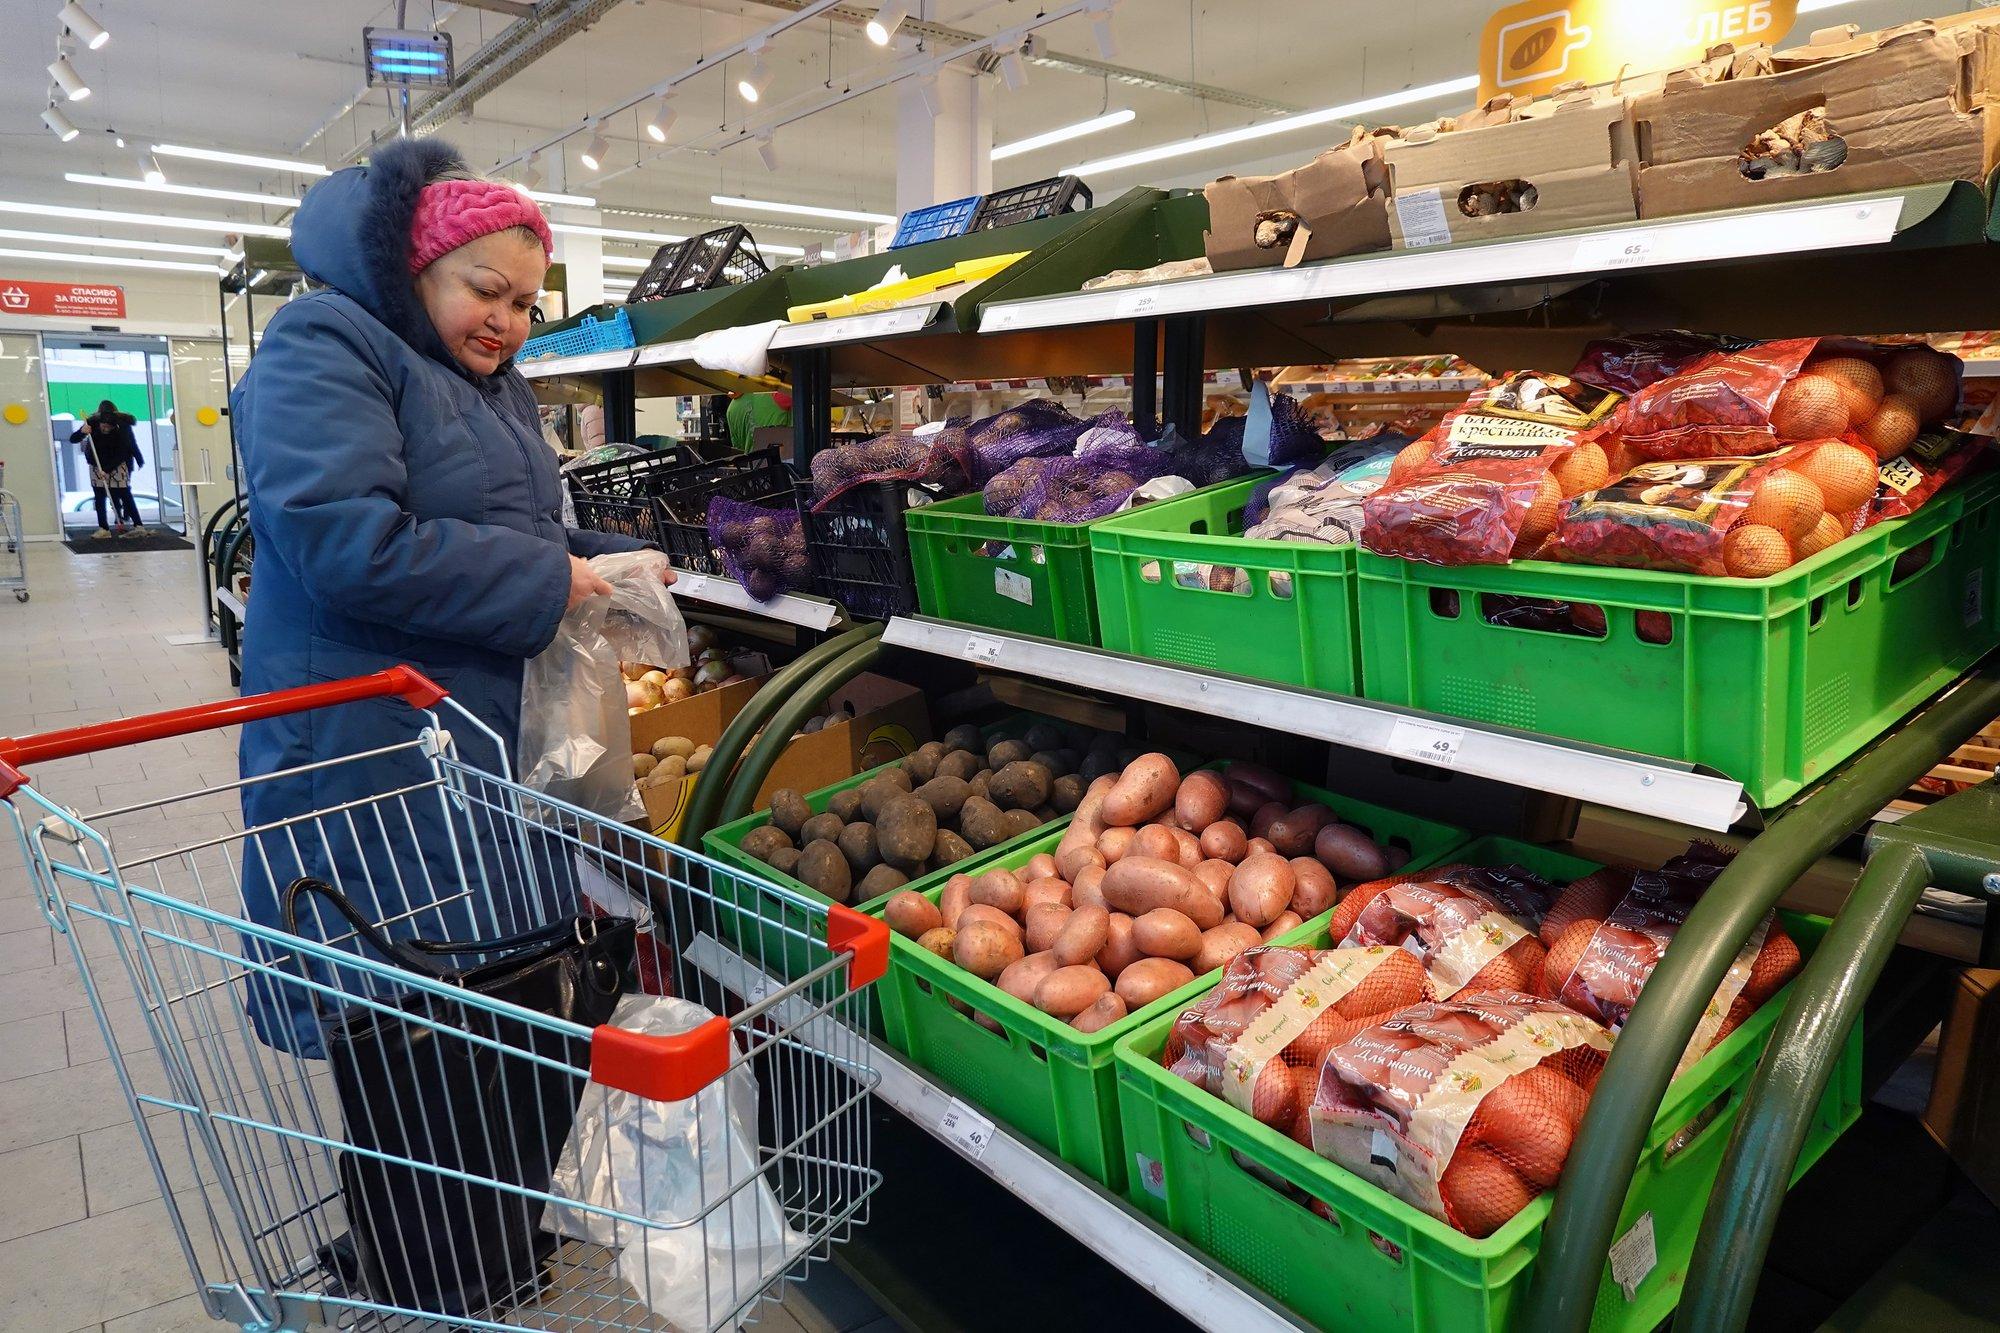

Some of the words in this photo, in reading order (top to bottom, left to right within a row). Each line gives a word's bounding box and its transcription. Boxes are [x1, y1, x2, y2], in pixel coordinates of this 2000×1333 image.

[1624, 244, 1642, 255] 65
[71, 287, 117, 297] СПАСИБО
[55, 294, 69, 303] ЗА
[70, 295, 118, 305] ПОКУПКУ!
[1456, 447, 1538, 458] КАРТОФЕЛЬ
[1432, 741, 1450, 752] 49
[1407, 890, 1433, 904] Для
[1599, 960, 1631, 983] Для
[1247, 981, 1281, 995] жарки
[1353, 1049, 1385, 1065] Для
[1386, 1059, 1433, 1080] жарки
[969, 1131, 982, 1144] 40
